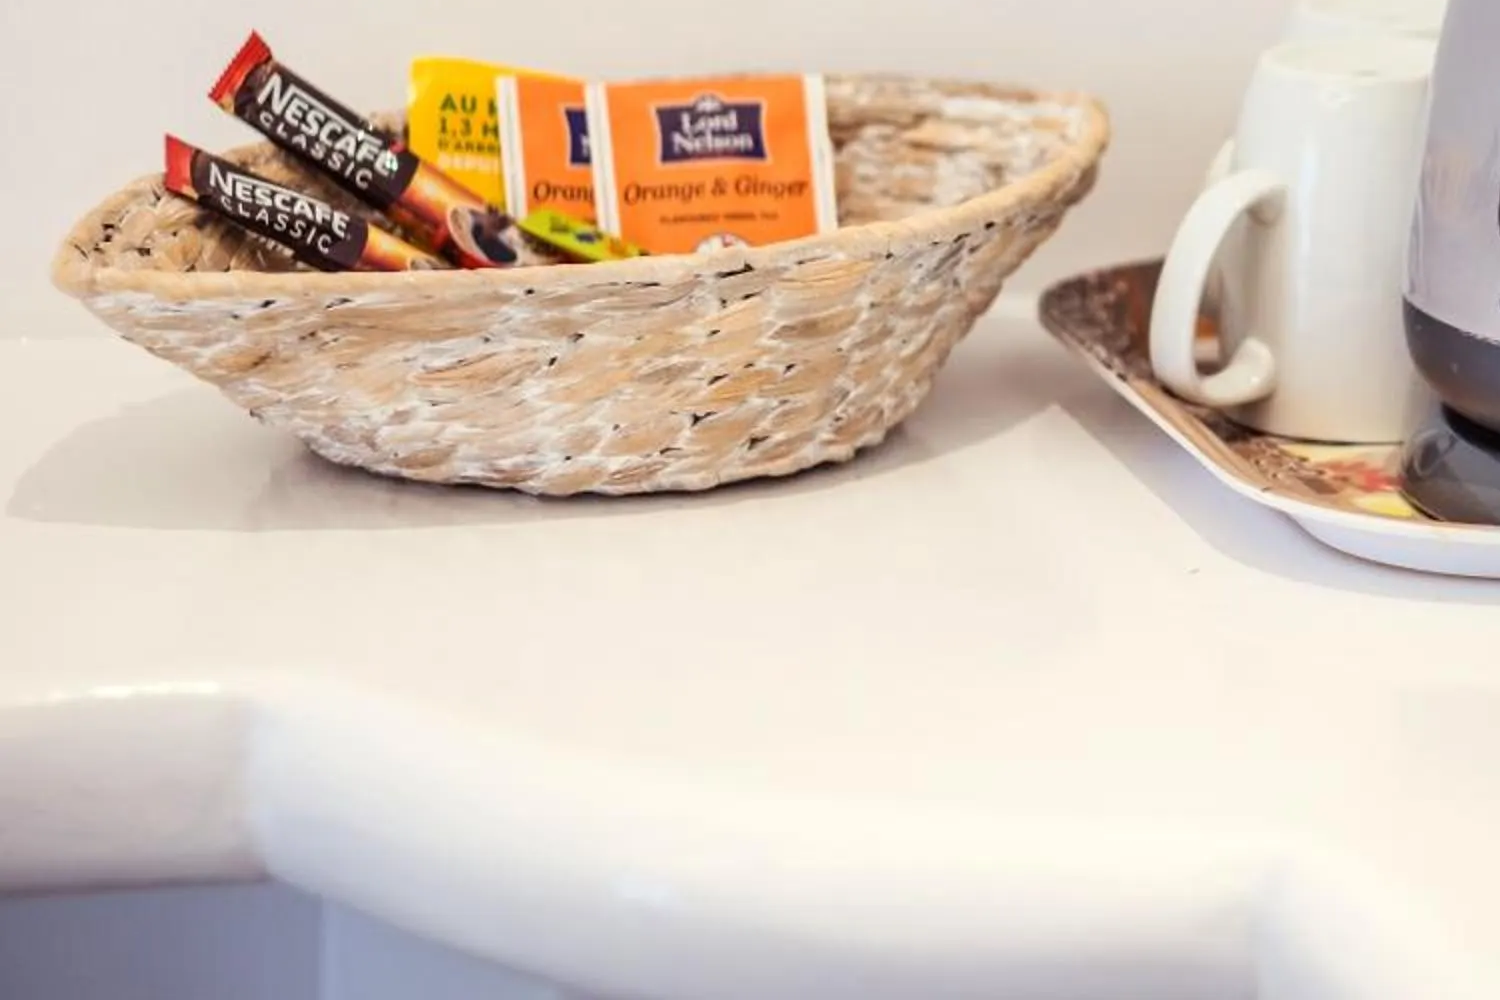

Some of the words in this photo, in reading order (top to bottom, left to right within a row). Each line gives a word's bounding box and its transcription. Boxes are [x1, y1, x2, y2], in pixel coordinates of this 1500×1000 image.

[440, 92, 477, 114] AU
[680, 110, 738, 134] Lord
[259, 111, 373, 191] CLASSIC
[672, 130, 754, 154] Nelson
[623, 179, 706, 207] Orange
[710, 176, 728, 198] &
[735, 173, 810, 200] Ginger
[220, 195, 333, 255] CLASSIC
